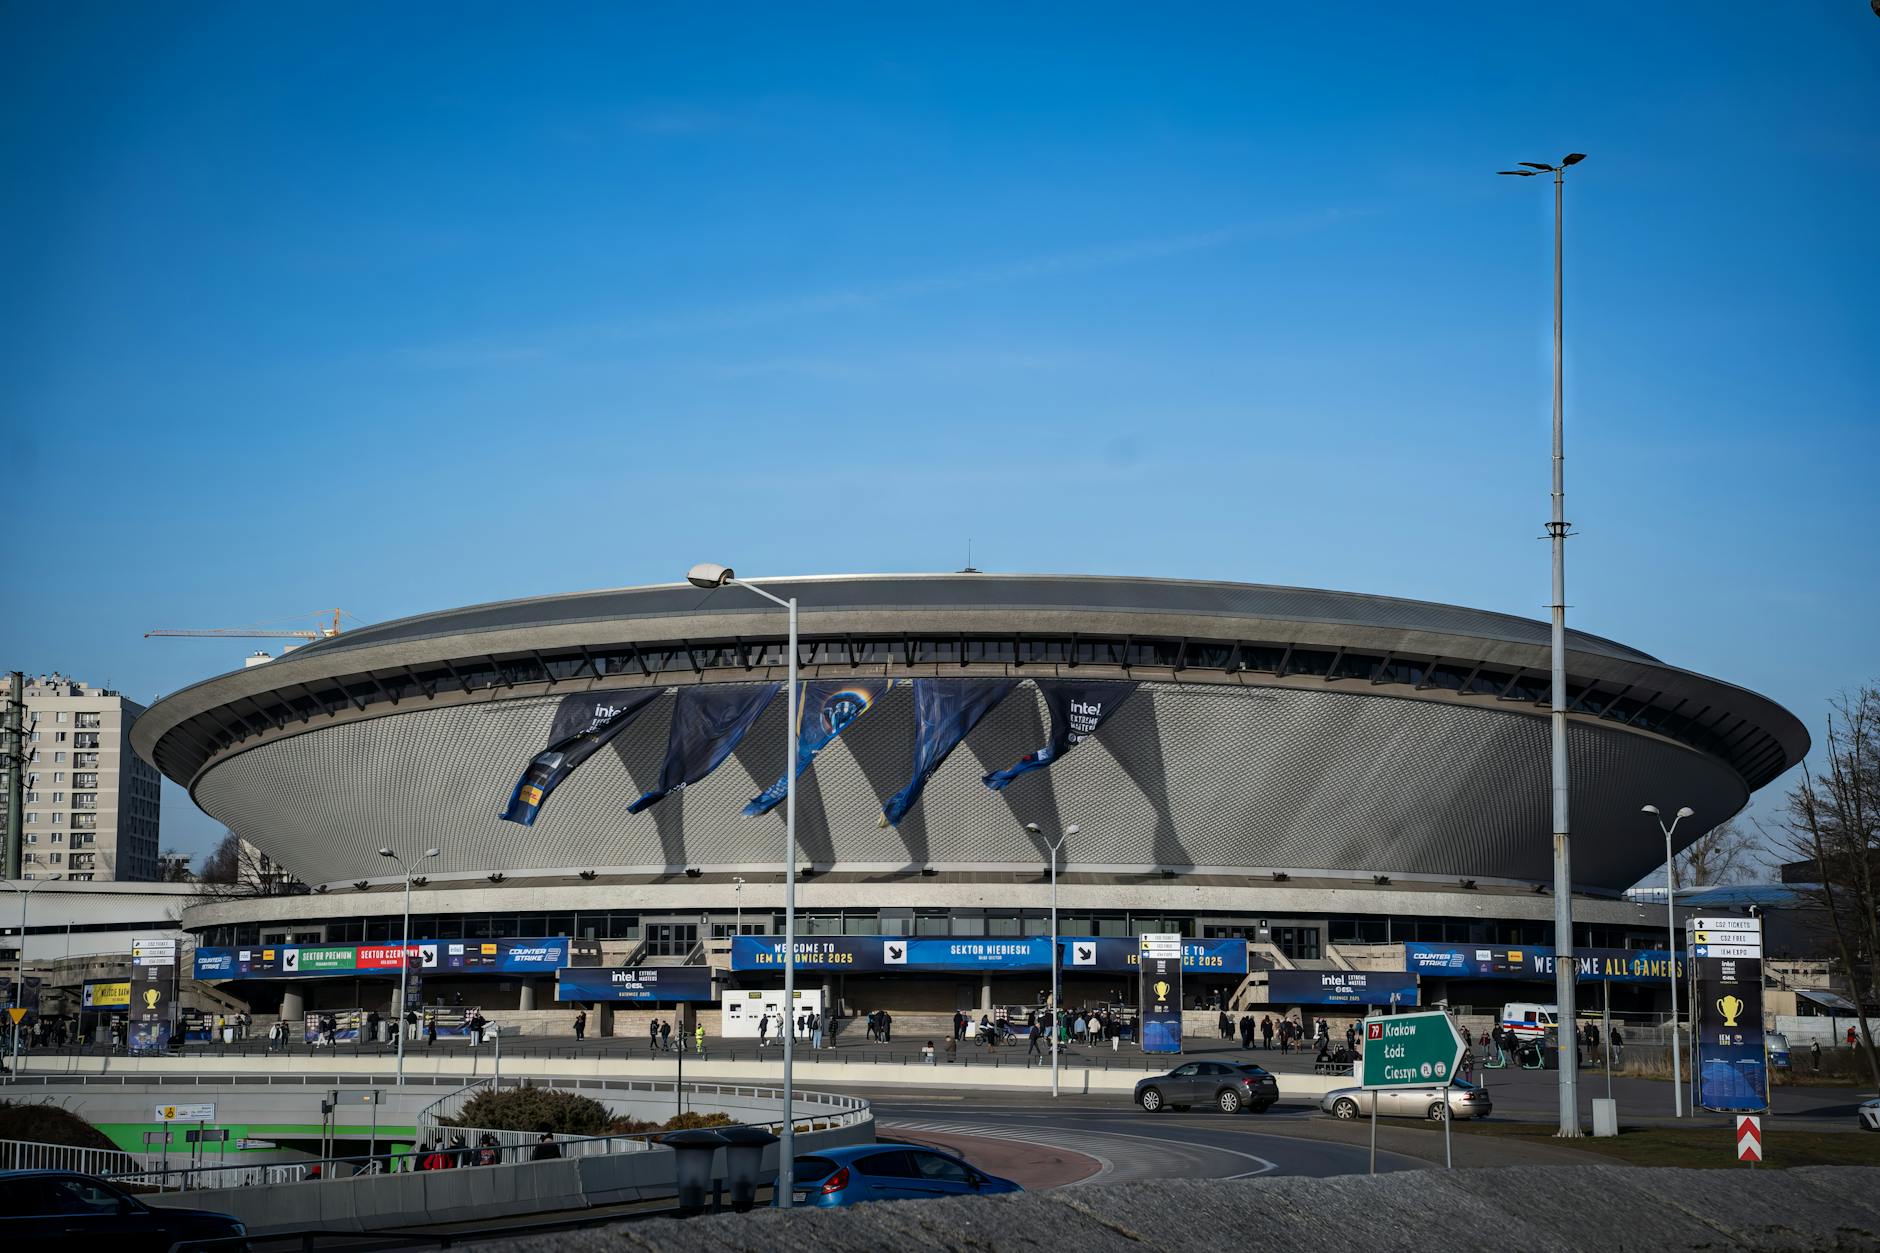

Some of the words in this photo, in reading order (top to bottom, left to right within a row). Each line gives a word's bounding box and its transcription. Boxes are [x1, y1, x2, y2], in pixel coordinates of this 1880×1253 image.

[1070, 699, 1101, 716] intel
[774, 943, 819, 953] WECOME
[823, 943, 835, 953] TO
[950, 944, 984, 955] SEKTOR
[987, 944, 1031, 955] NIEBIESKI
[1193, 945, 1205, 956] TO
[302, 952, 324, 961] SEKTOR
[325, 951, 352, 961] PREMIUM
[361, 950, 384, 959] SEKTOR
[755, 953, 773, 963] IEM
[776, 953, 824, 963] KOWICE
[828, 953, 853, 963] 2025
[1198, 956, 1223, 966] 2025
[1534, 955, 1599, 975] WEME
[1605, 958, 1629, 976] ALL
[611, 971, 637, 982] intel
[1321, 974, 1346, 986] intel
[1371, 1025, 1380, 1037] 79
[1385, 1021, 1417, 1038] Kraków
[1384, 1043, 1405, 1059] Łódź
[1384, 1065, 1417, 1083] Cieszyn
